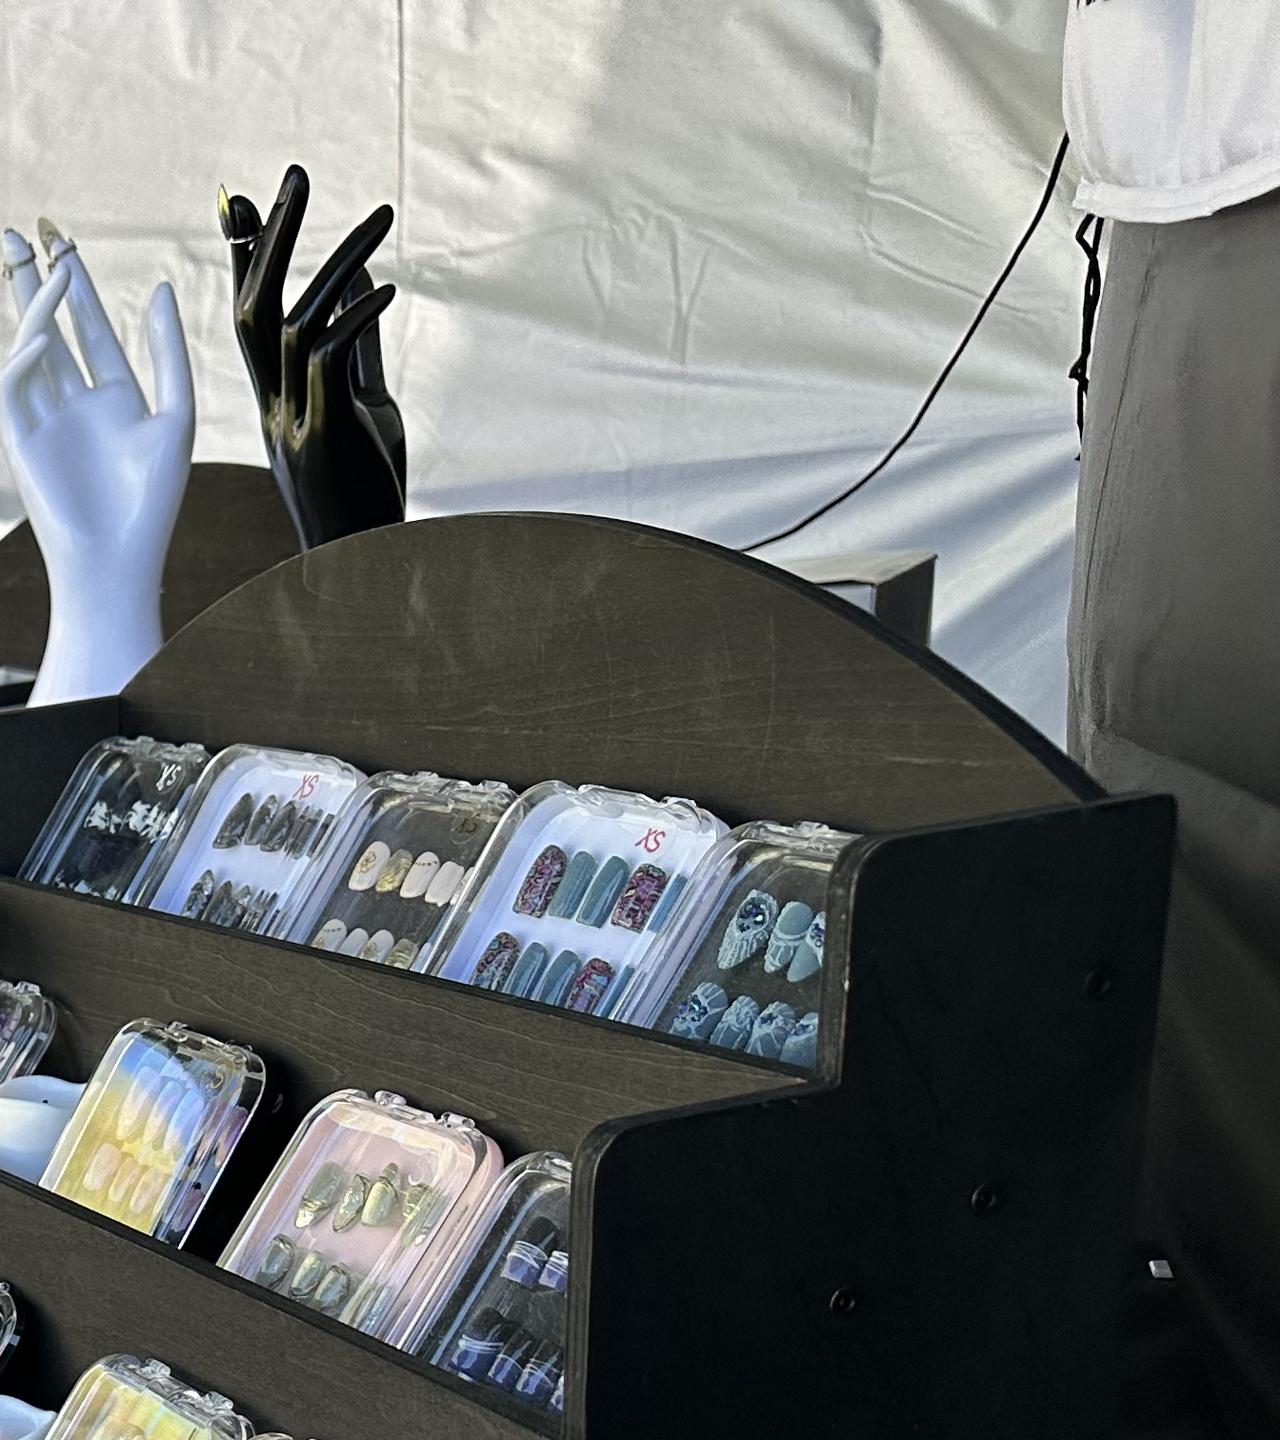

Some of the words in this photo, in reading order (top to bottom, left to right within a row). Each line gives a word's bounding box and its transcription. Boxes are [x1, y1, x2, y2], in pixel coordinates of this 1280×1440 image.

[155, 763, 182, 792] XS
[292, 773, 320, 800] XS
[634, 826, 667, 853] XS
